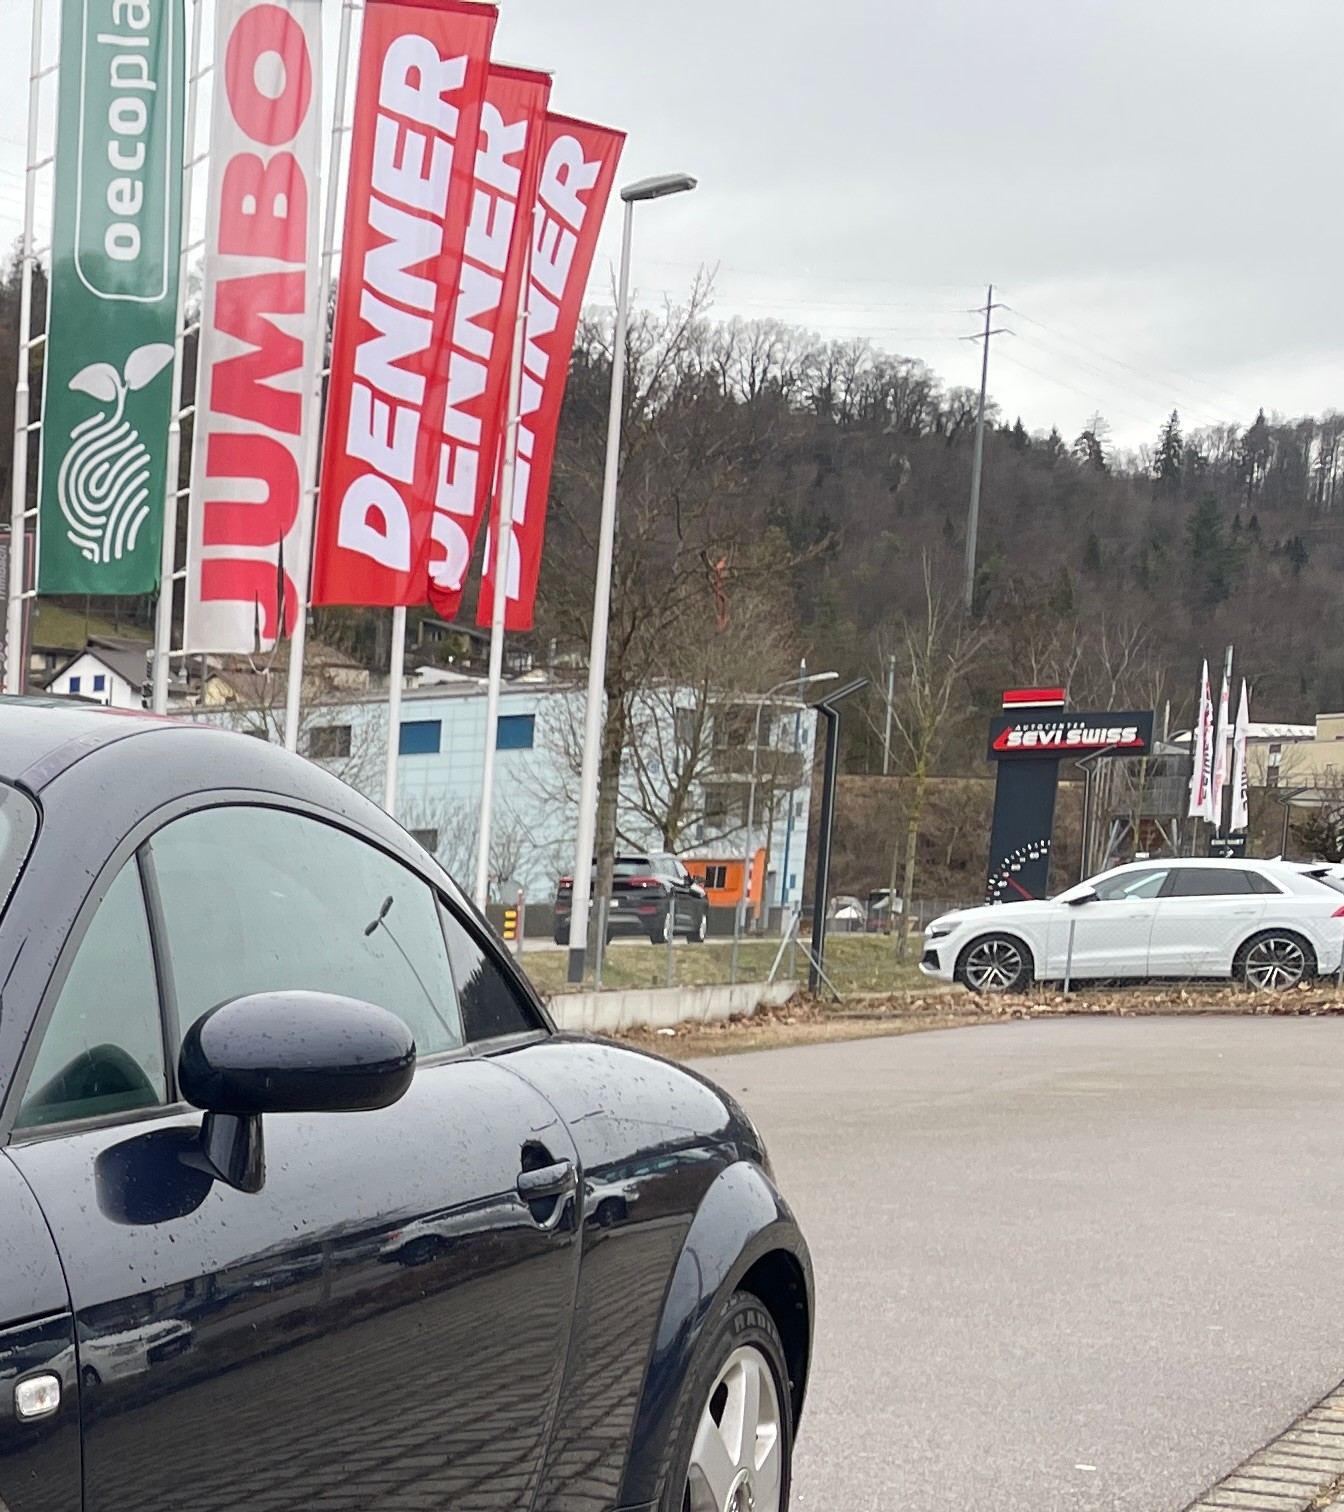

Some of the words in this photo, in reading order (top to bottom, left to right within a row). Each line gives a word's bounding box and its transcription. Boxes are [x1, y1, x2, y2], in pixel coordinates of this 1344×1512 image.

[200, 3, 312, 639] JUMBO
[337, 33, 468, 573] DENNER
[1006, 730, 1063, 747] SEVI
[1065, 726, 1138, 744] SWISS
[1014, 721, 1086, 731] AUTOCENTER
